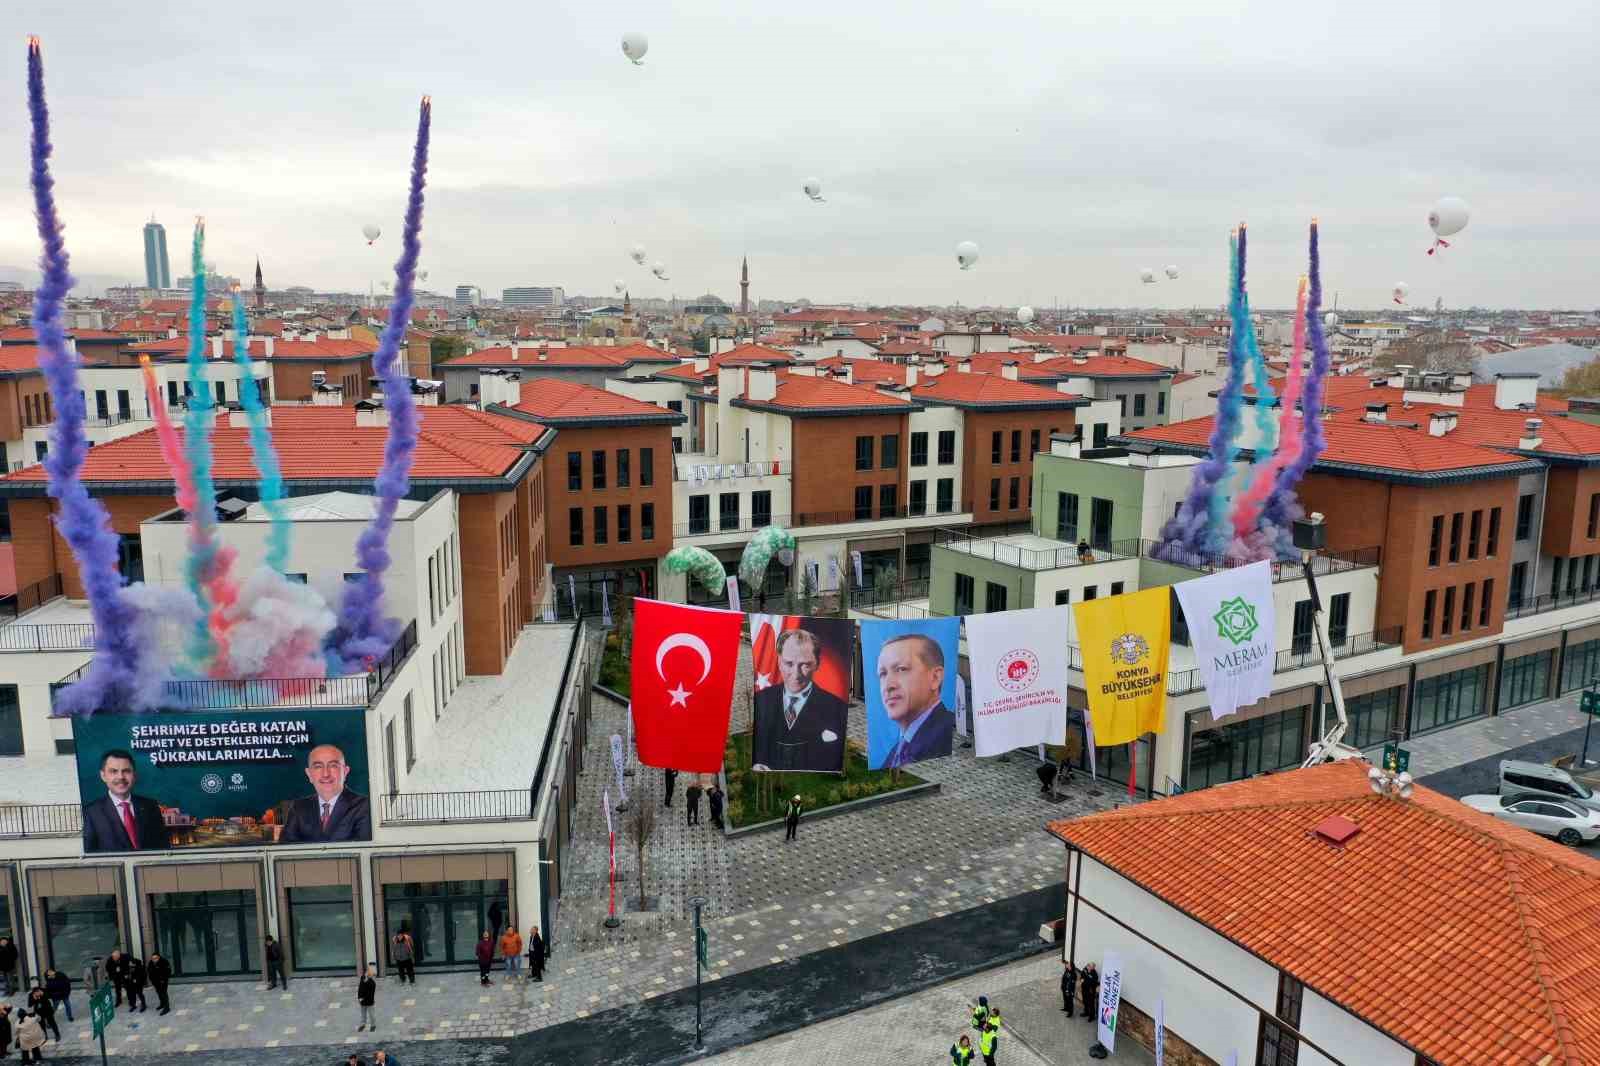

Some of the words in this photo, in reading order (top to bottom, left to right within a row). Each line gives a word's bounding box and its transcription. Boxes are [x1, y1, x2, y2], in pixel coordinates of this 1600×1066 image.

[1214, 641, 1268, 671] MERAM
[1116, 666, 1149, 679] KONYA
[131, 724, 208, 739] ŞEHRİMİZE
[210, 720, 257, 734] DEĞER
[261, 720, 307, 733] KATAN
[130, 738, 175, 749] HİZMET
[176, 738, 192, 748] VE
[195, 735, 282, 748] DESTEKLERİNİZ
[285, 733, 309, 746] İÇİN
[150, 748, 293, 765] ŞÜKRANLARIMIZLA...
